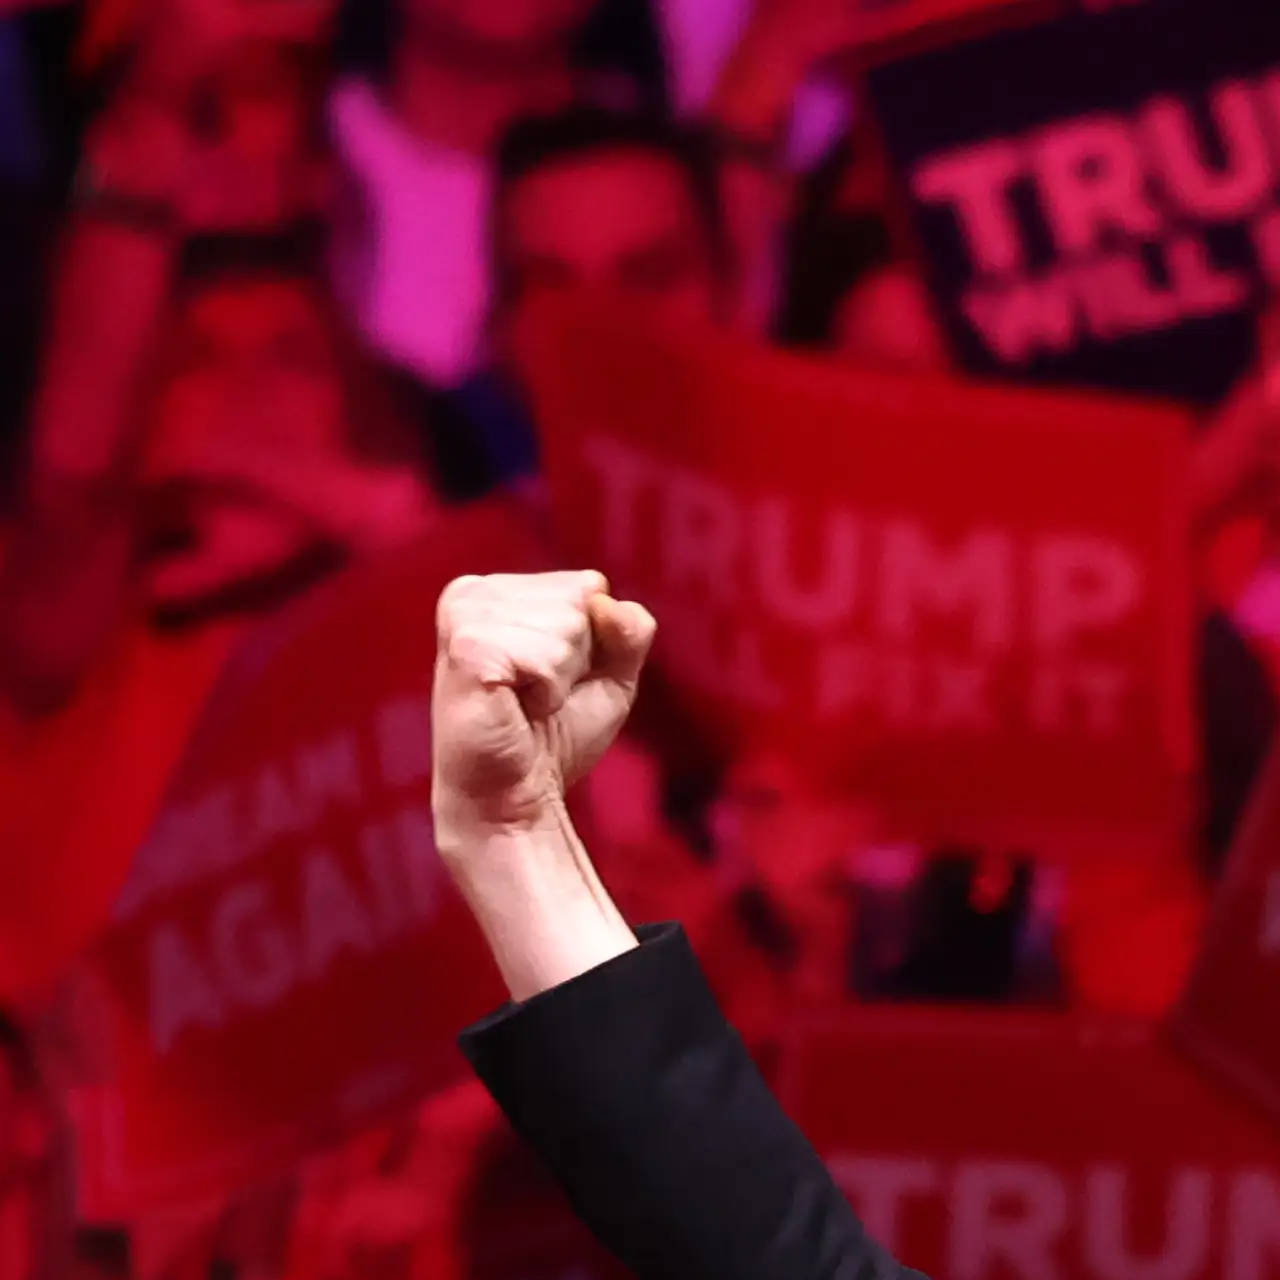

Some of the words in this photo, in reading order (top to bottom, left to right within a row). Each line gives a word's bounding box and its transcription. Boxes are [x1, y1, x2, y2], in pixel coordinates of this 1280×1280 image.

[957, 230, 1252, 365] WILL
[576, 430, 1142, 652] TRUMP
[812, 640, 996, 728] FIX
[1030, 650, 1128, 736] IT
